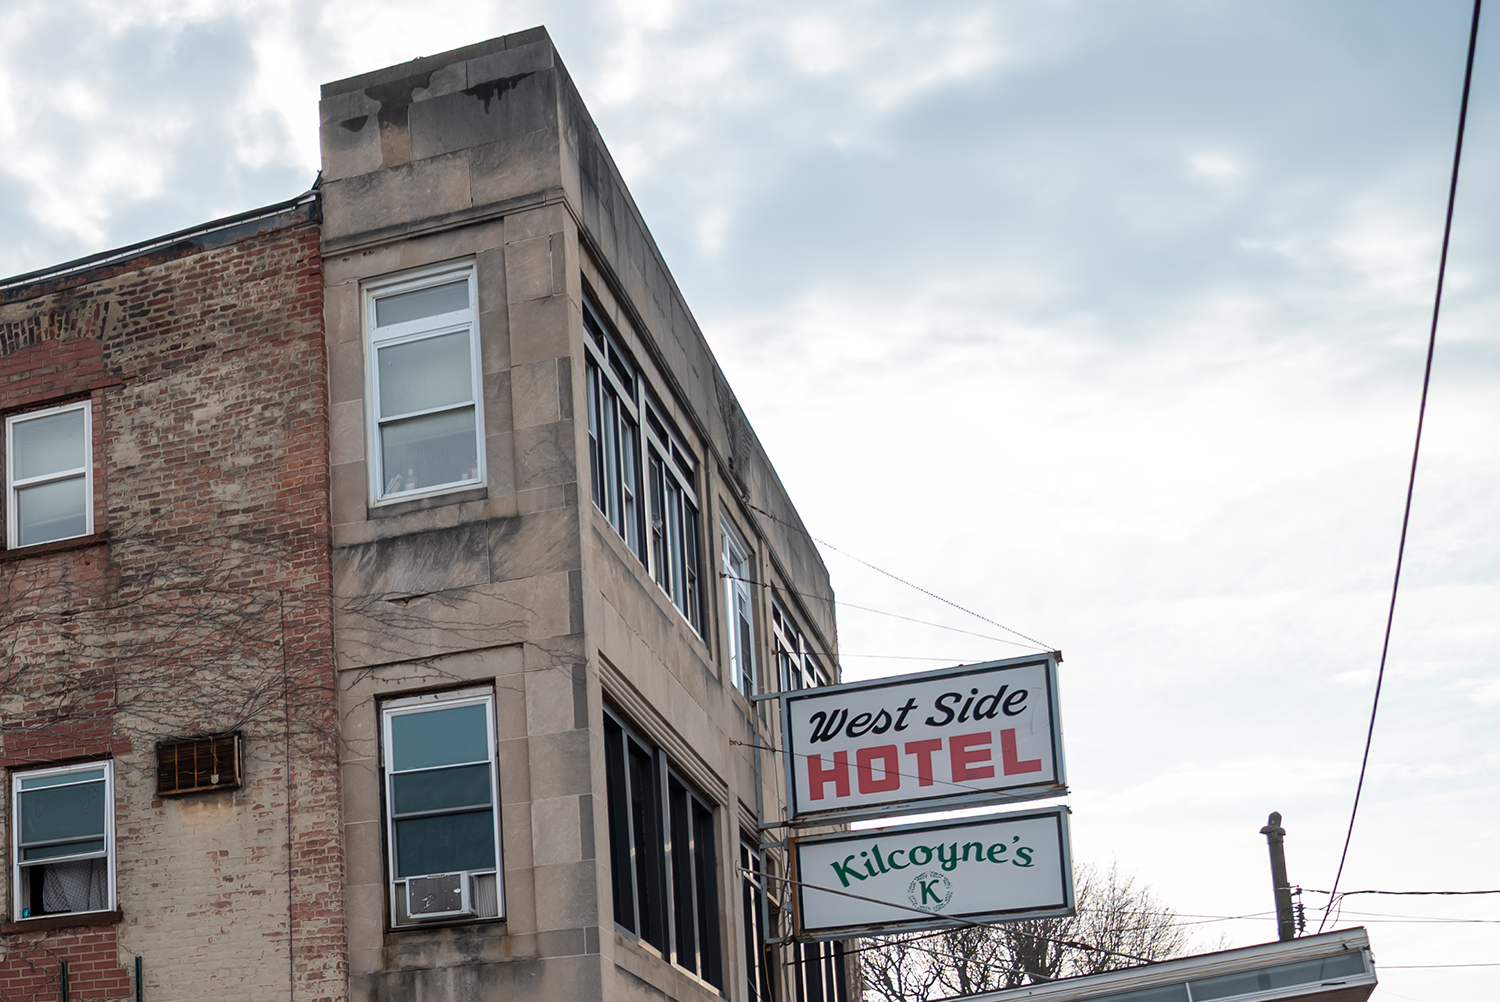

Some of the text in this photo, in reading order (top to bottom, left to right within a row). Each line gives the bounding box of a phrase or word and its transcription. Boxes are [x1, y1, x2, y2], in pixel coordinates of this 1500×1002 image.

[809, 684, 1029, 744] West Side
[806, 728, 1042, 801] HOTEL
[829, 835, 1035, 888] Kilcoyne's
[918, 879, 943, 905] K
